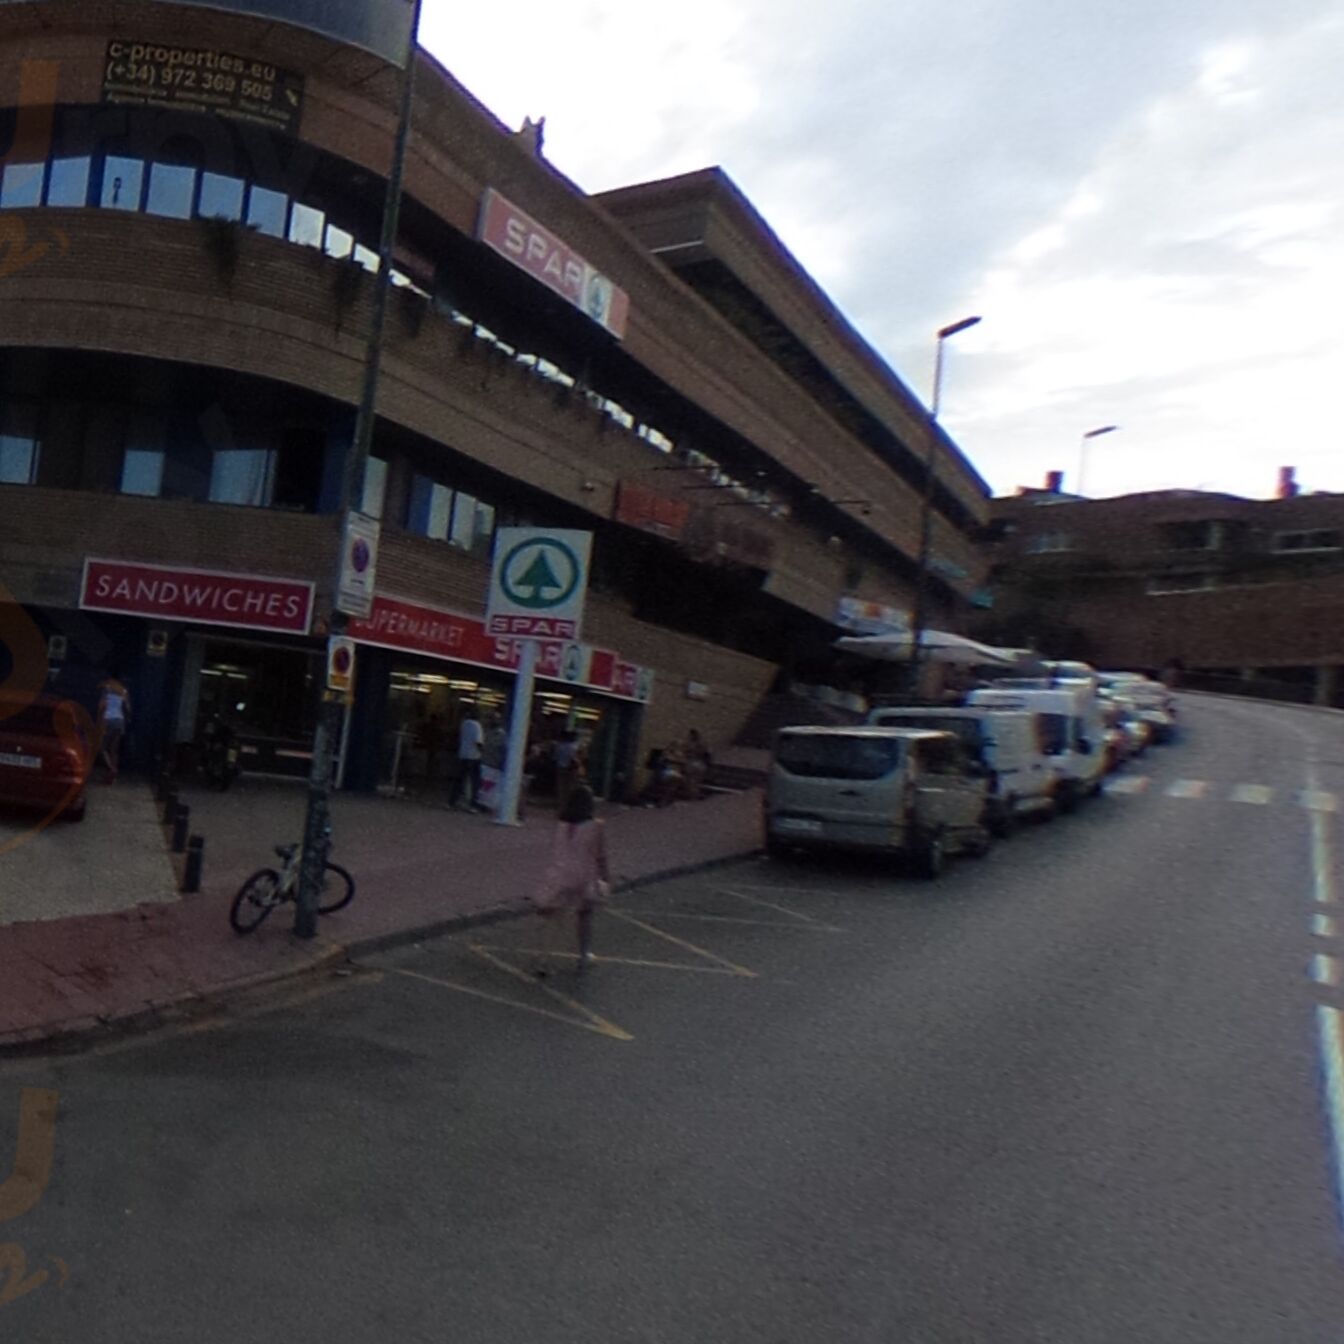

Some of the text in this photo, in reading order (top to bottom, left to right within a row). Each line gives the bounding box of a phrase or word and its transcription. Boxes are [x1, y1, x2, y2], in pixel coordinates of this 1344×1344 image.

[107, 62, 156, 84] (+34)
[161, 67, 197, 87] 972
[201, 74, 236, 92] 369
[240, 80, 273, 101] 505
[109, 43, 275, 82] c-properties.eu
[503, 217, 583, 287] SPAR
[95, 575, 302, 618] SANDWICHES
[491, 618, 574, 637] SPAR
